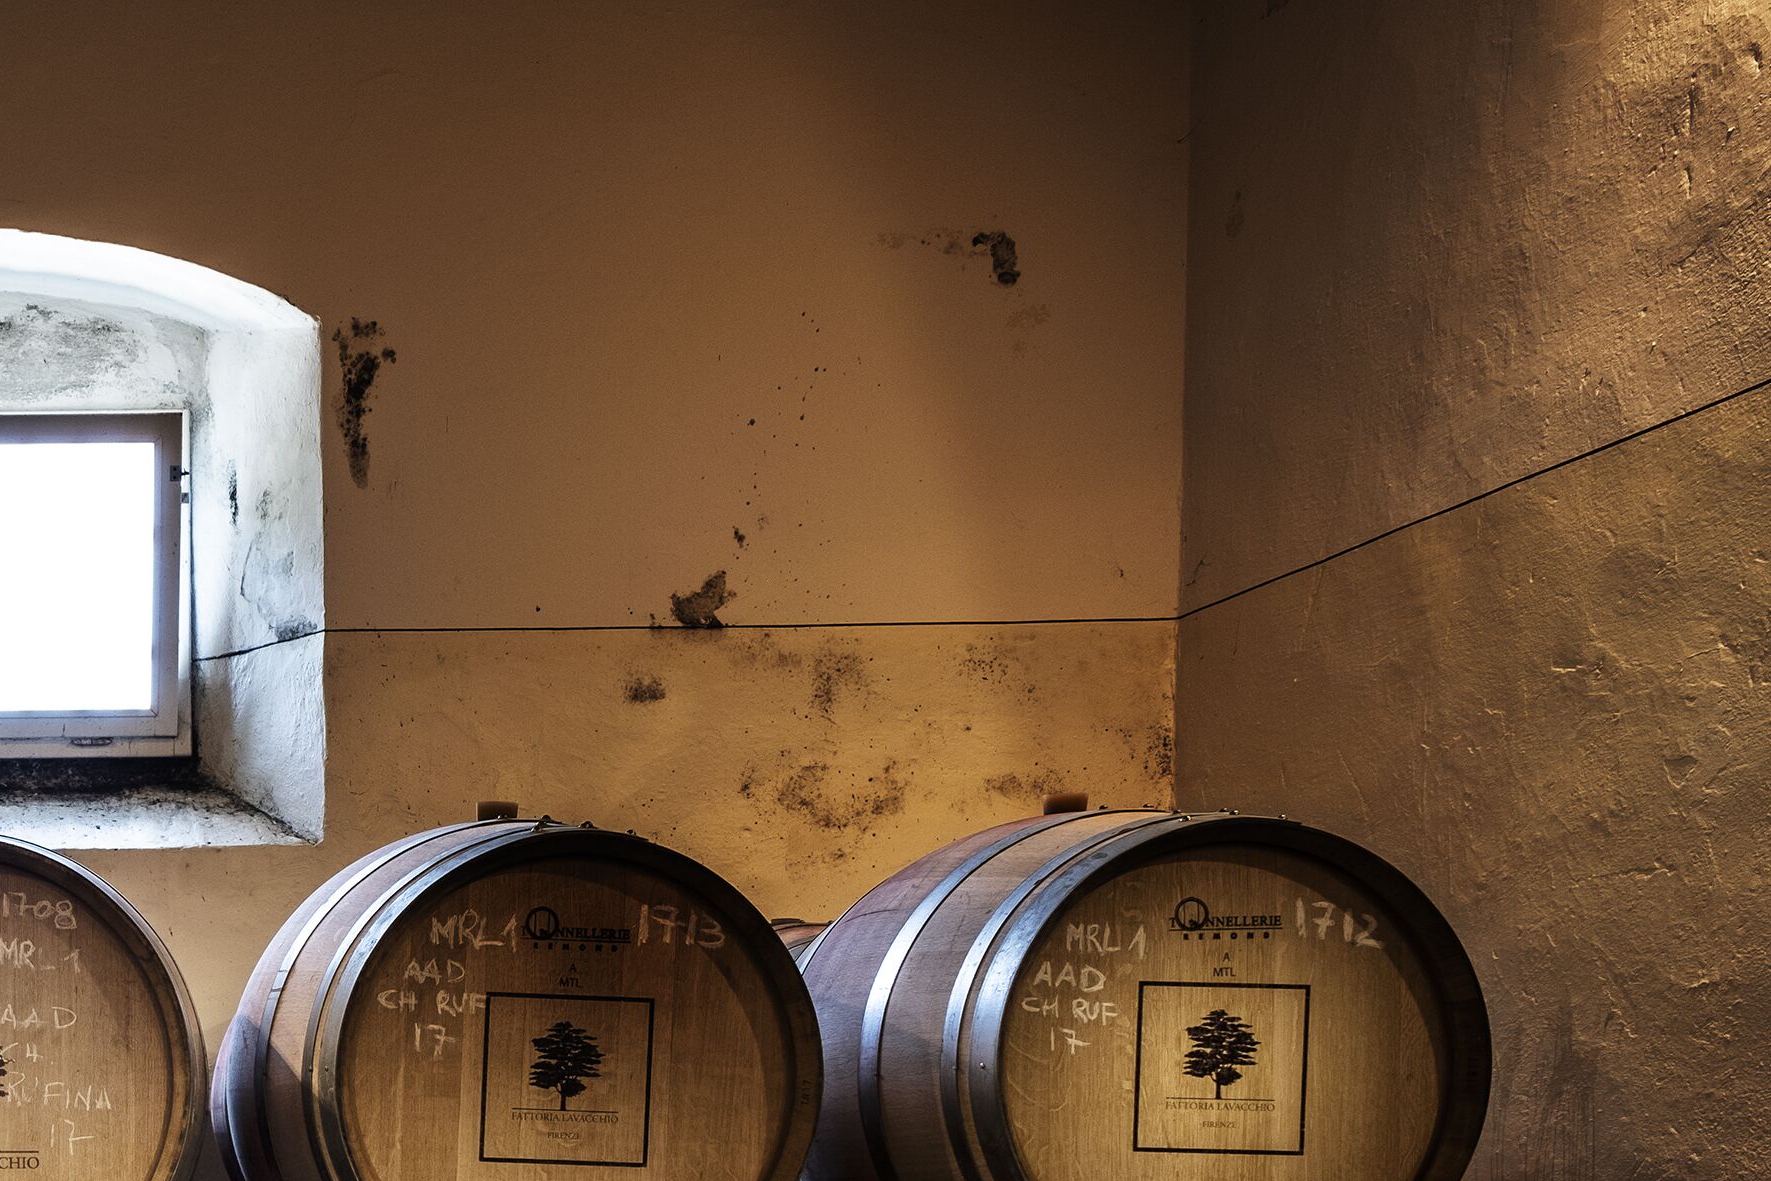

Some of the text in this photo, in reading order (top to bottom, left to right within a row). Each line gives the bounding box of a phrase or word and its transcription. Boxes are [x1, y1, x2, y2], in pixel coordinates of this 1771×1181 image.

[3, 892, 77, 930] 1708
[1169, 896, 1282, 930] TONNELLERIE
[1295, 897, 1381, 949] 1712
[638, 904, 725, 949] 1713
[558, 977, 583, 989] MTL
[1033, 962, 1107, 992] AAD
[1213, 967, 1236, 977] MTL
[1, 1003, 77, 1030] AAD
[378, 989, 486, 1016] CH RUF
[1022, 996, 1119, 1025] CH RUF
[415, 1023, 455, 1061] 17
[1050, 1028, 1091, 1055] 17
[512, 1112, 619, 1125] FATTORIA LAVACCHIO
[1166, 1101, 1275, 1112] FATTORIA LAVACCHIO
[50, 1119, 94, 1155] 17
[1202, 1120, 1237, 1129] FIRENZE
